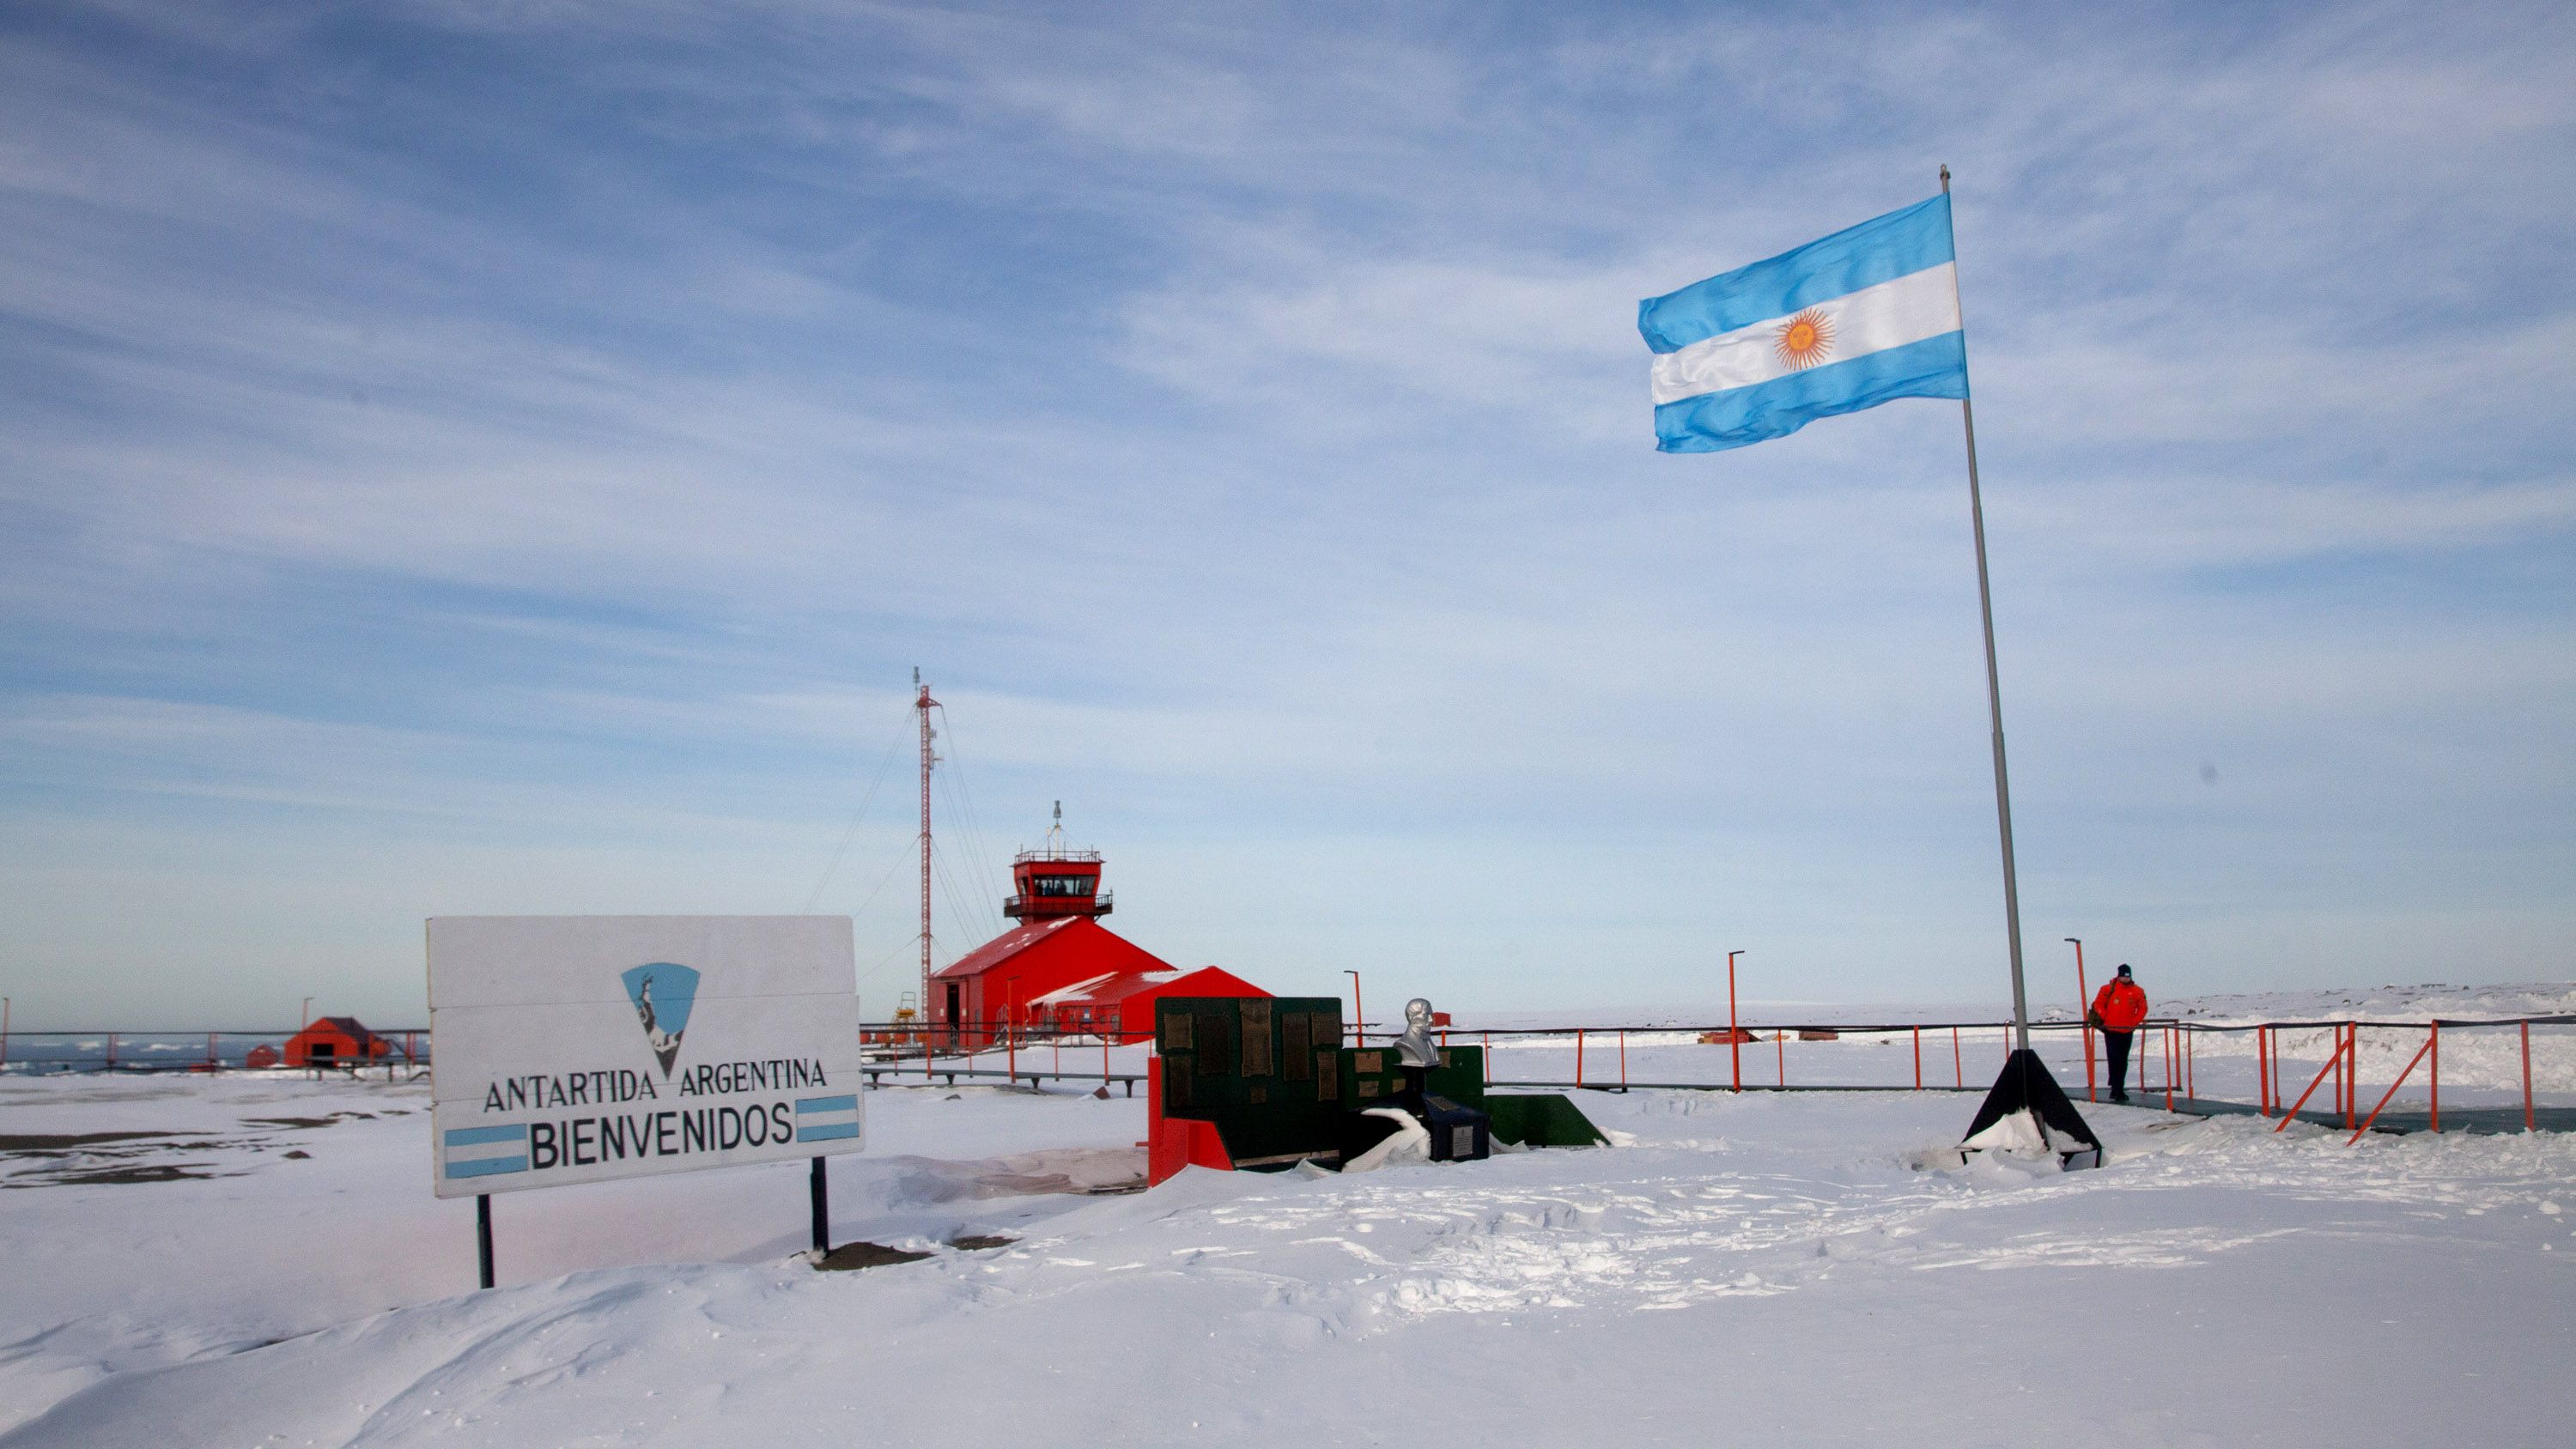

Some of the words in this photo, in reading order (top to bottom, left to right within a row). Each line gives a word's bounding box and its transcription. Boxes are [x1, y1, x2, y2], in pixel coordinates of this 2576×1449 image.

[484, 1070, 658, 1113] ANTARTIDA
[679, 1058, 827, 1096] ARGENTINA
[531, 1102, 793, 1169] BIENVENIDOS
